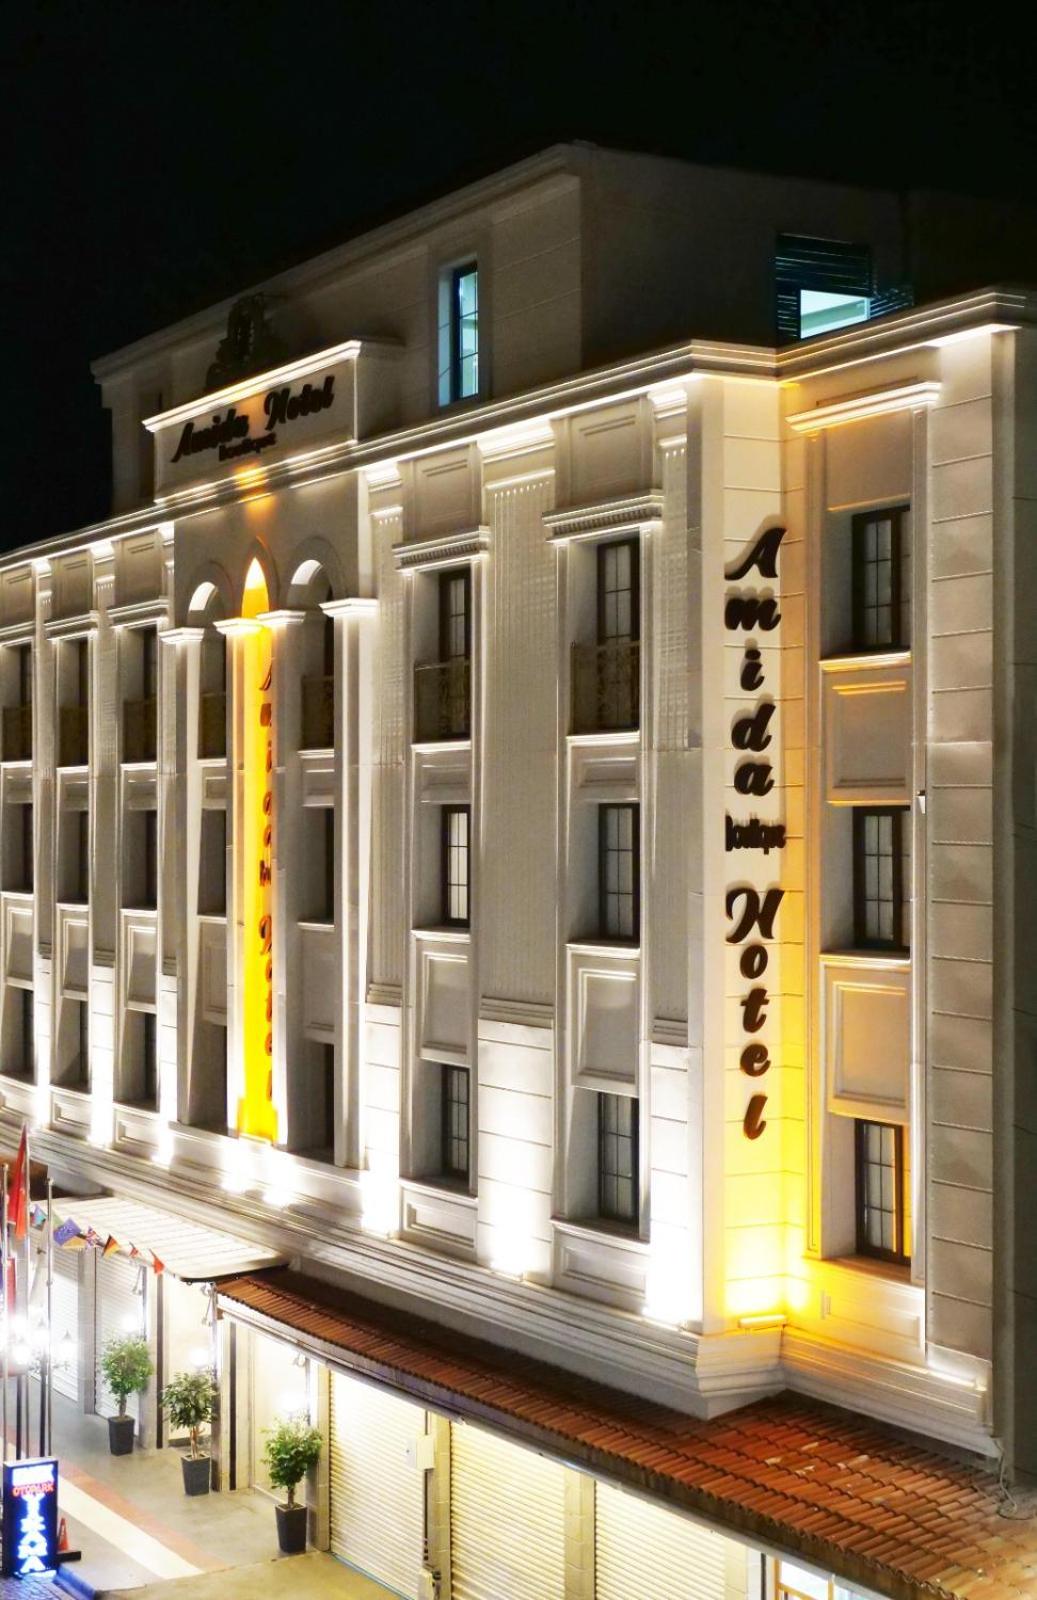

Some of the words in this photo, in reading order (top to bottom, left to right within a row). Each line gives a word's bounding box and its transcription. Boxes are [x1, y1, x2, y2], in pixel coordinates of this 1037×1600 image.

[264, 375, 335, 431] Hotel
[724, 527, 787, 797] Amida
[725, 888, 785, 1140] Hotel
